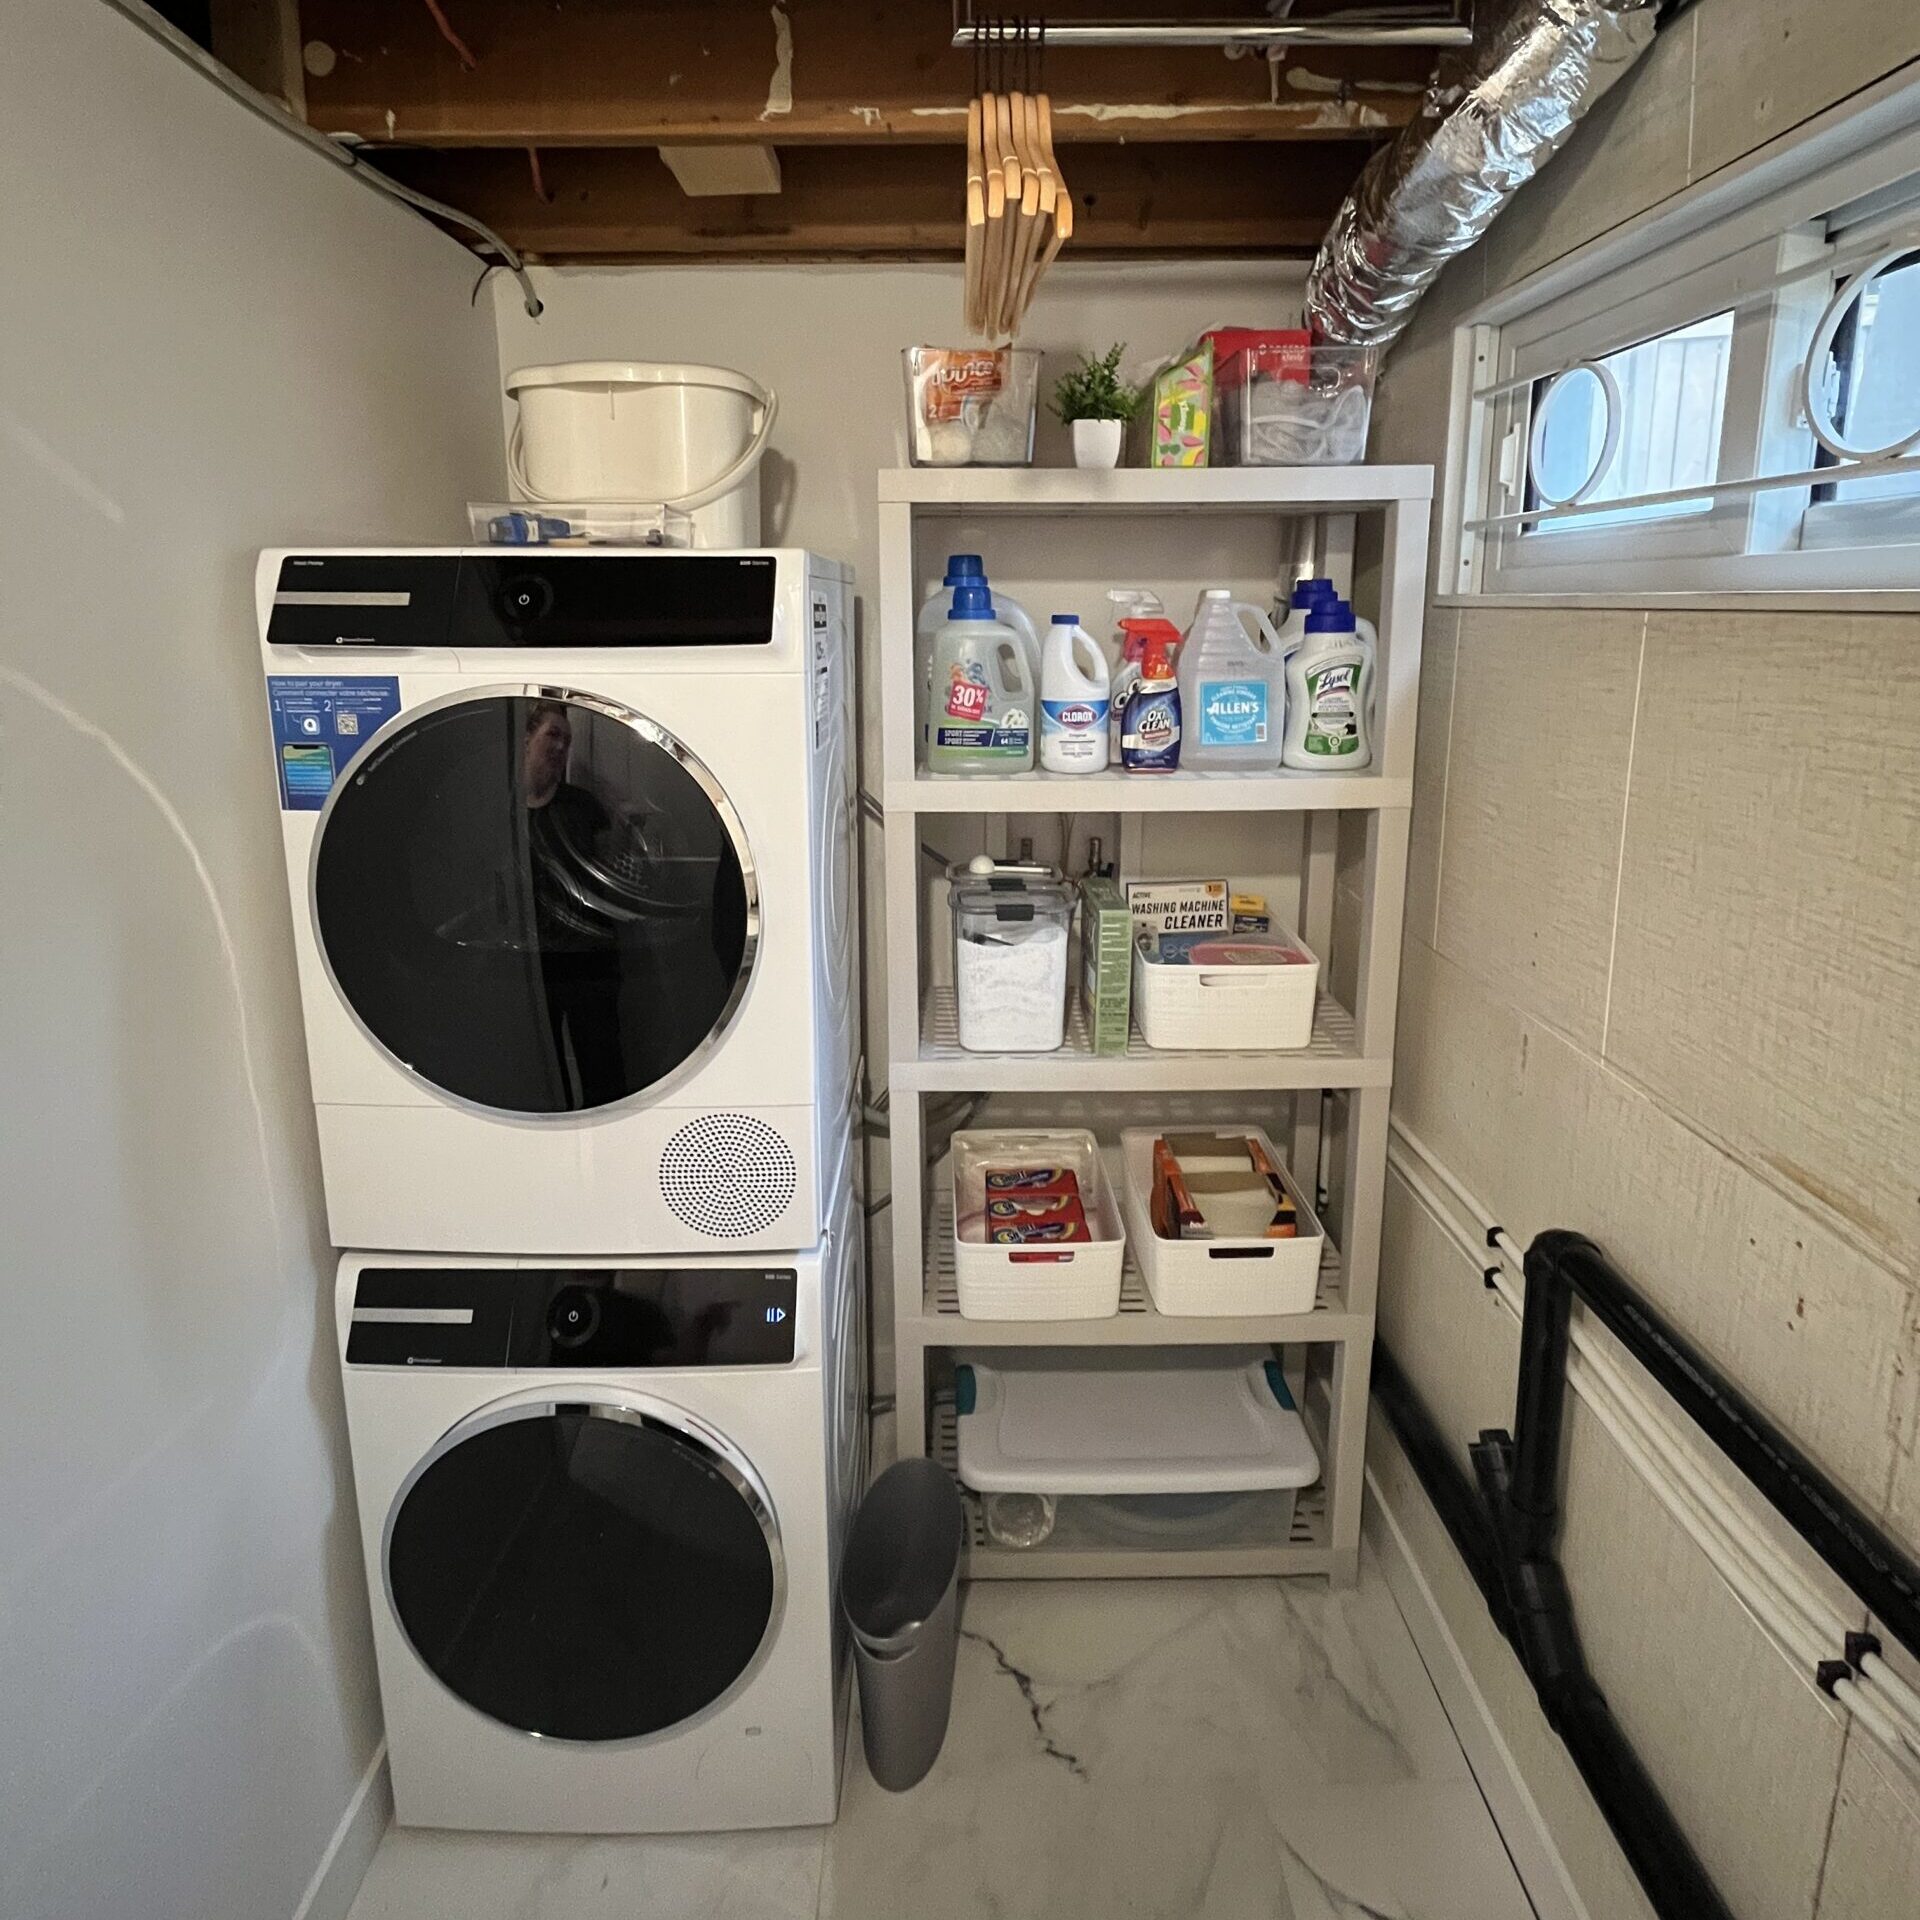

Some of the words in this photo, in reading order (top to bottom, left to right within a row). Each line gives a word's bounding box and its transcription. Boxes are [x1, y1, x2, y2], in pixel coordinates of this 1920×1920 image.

[1319, 668, 1351, 689] Lysol
[952, 684, 984, 707] 30%
[274, 700, 281, 711] 1
[324, 700, 332, 711] 2
[1206, 701, 1260, 715] ALLEN'S
[1062, 711, 1093, 722] CLOROX
[1147, 710, 1165, 721] OXI
[1138, 719, 1170, 732] CLEAN
[1131, 901, 1176, 915] WASHING
[1179, 899, 1225, 911] MACHINE
[1164, 914, 1223, 930] CLEANER
